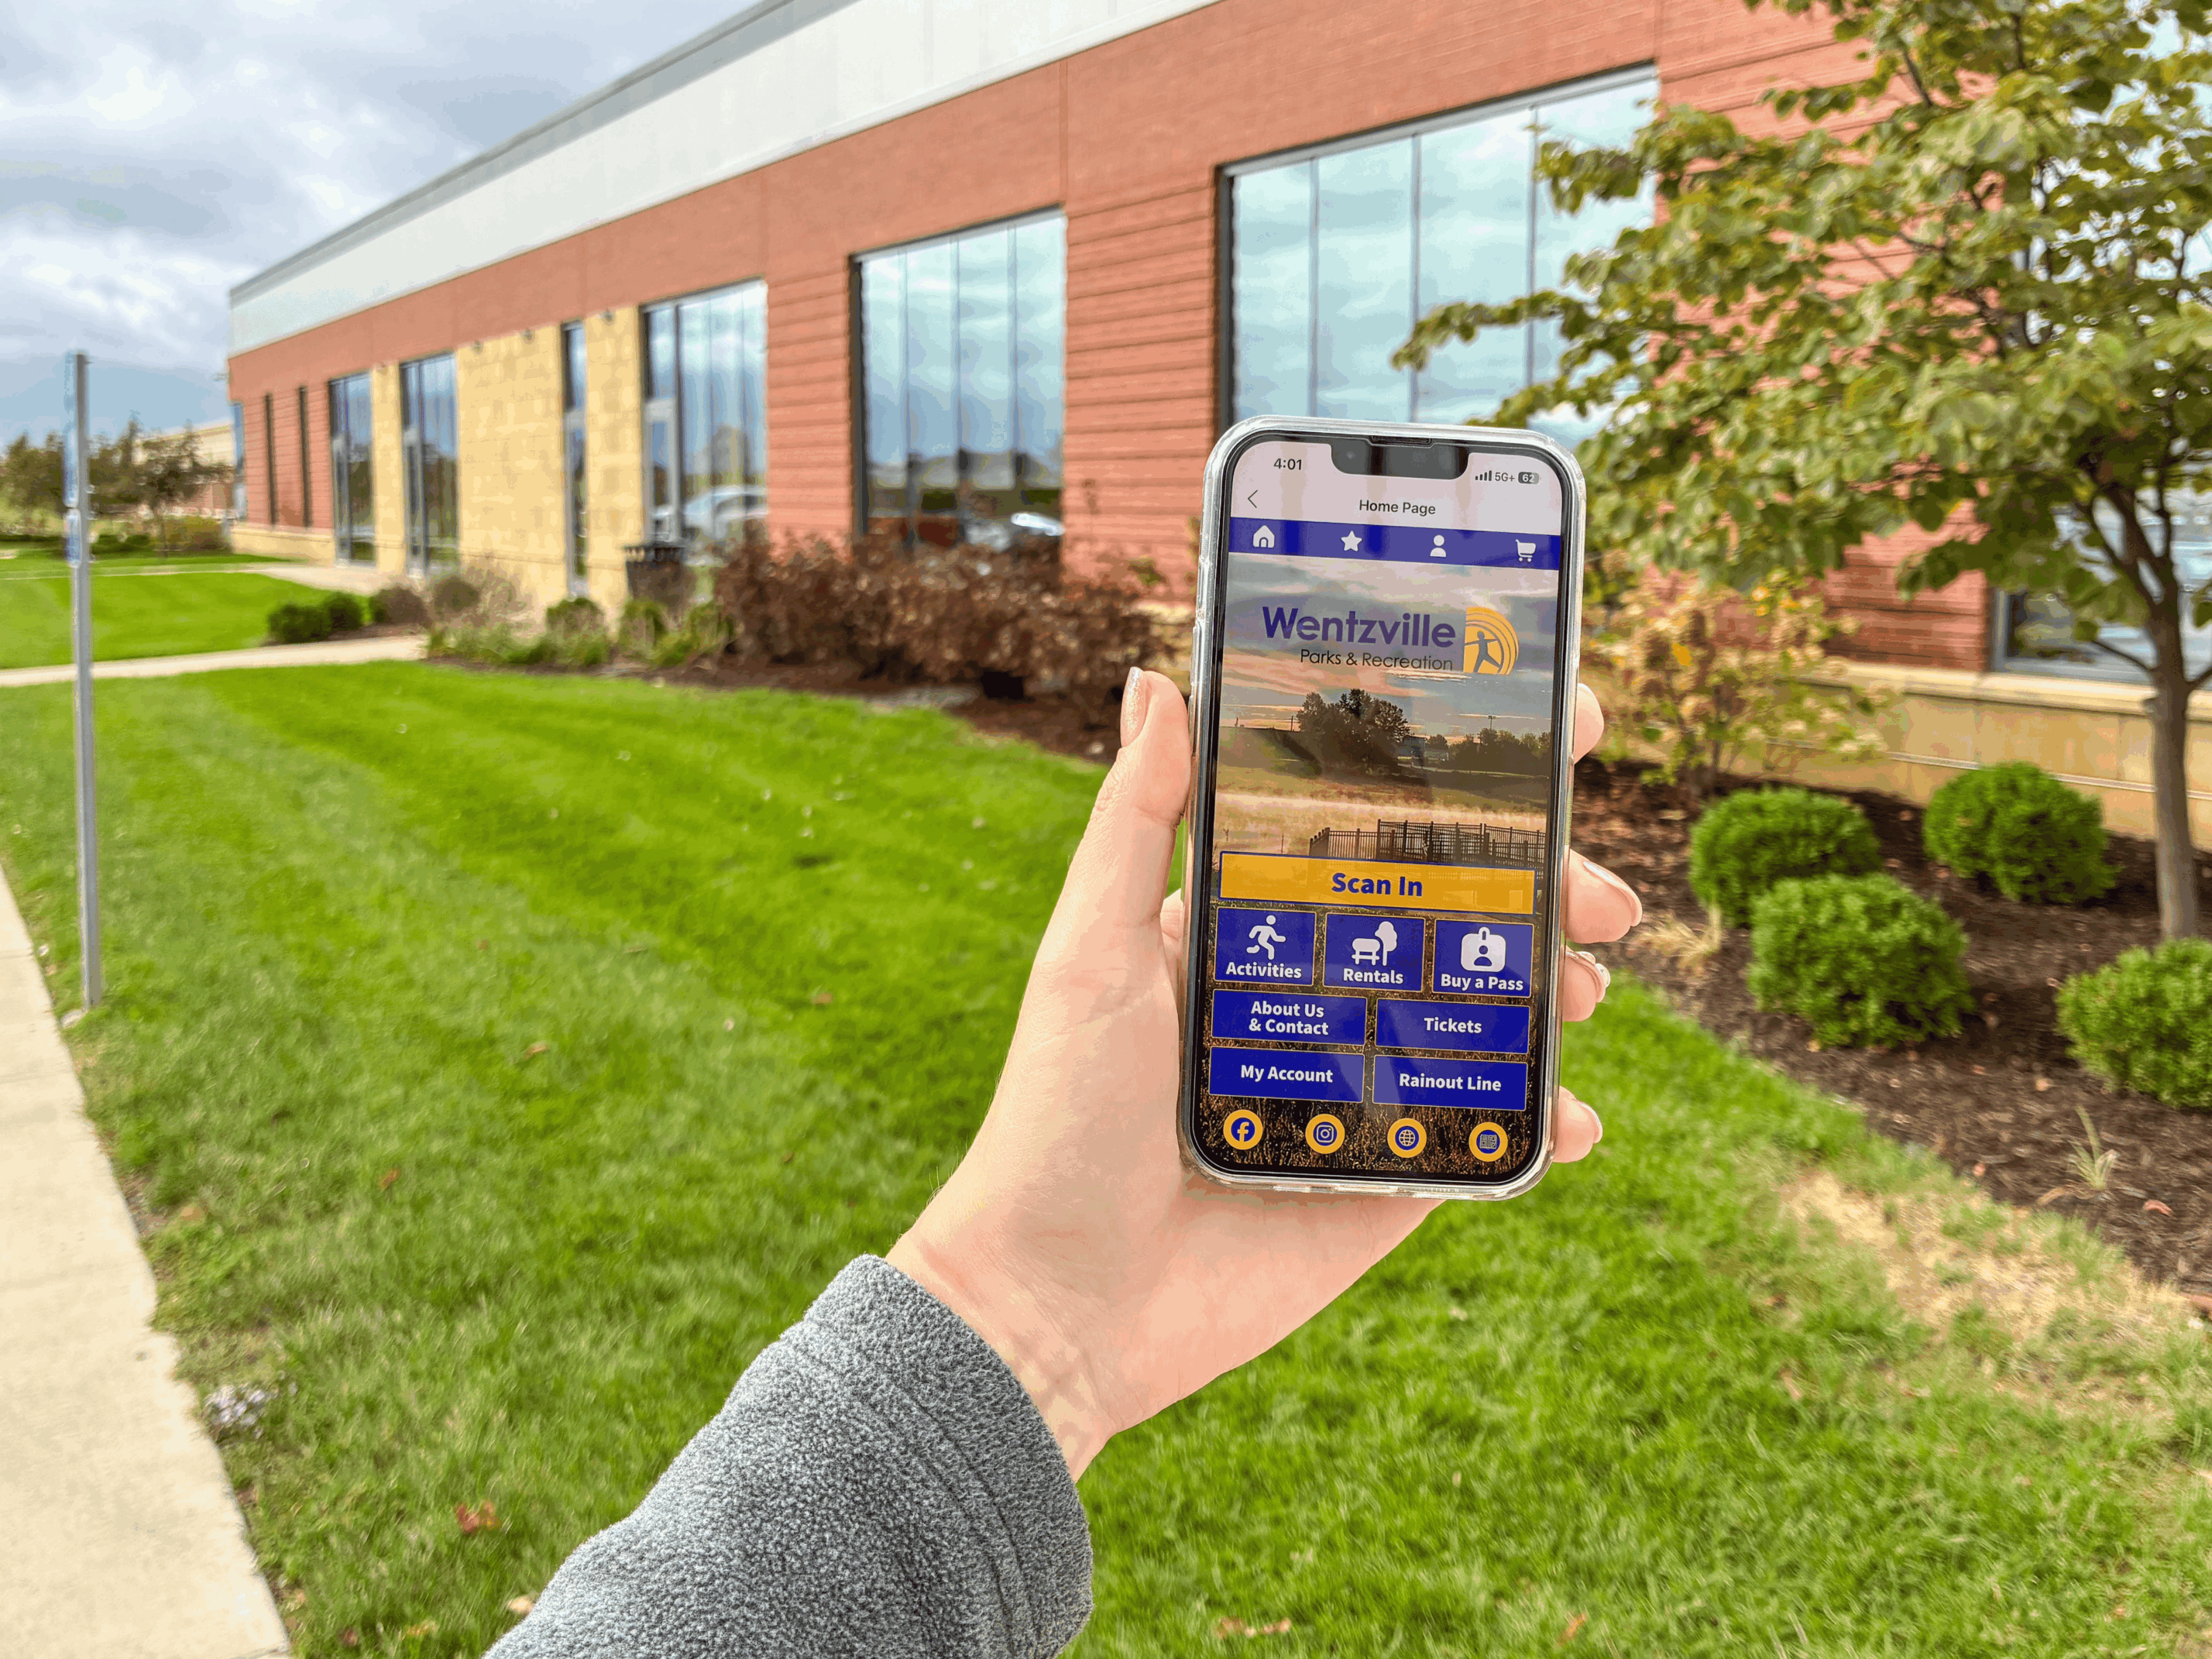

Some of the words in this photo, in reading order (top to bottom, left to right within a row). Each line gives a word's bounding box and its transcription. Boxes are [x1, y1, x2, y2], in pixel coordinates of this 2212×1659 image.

[1273, 458, 1303, 471] 4:01
[1495, 472, 1515, 482] 5G+
[1522, 473, 1535, 483] 62
[1358, 499, 1399, 513] Home
[1403, 501, 1436, 517] Page
[1262, 606, 1456, 647] Wentzville
[1300, 649, 1341, 666] Parks
[1345, 653, 1358, 666] &
[1362, 653, 1453, 671] Recreation
[1331, 872, 1391, 895] Scan
[1399, 876, 1424, 897] In
[1225, 961, 1302, 979] Activities
[1342, 967, 1403, 984] Rentals
[1441, 974, 1472, 991] Buy
[1475, 978, 1484, 989] a
[1488, 976, 1523, 991] Pass
[1251, 1001, 1301, 1017] About
[1304, 1002, 1324, 1018] Us
[1249, 1018, 1262, 1032] &
[1265, 1018, 1329, 1036] Contact
[1424, 1017, 1482, 1034] Tickets
[1240, 1065, 1264, 1082] My
[1267, 1066, 1334, 1083] Account
[1399, 1073, 1464, 1091] Rainout
[1467, 1075, 1502, 1091] Line
